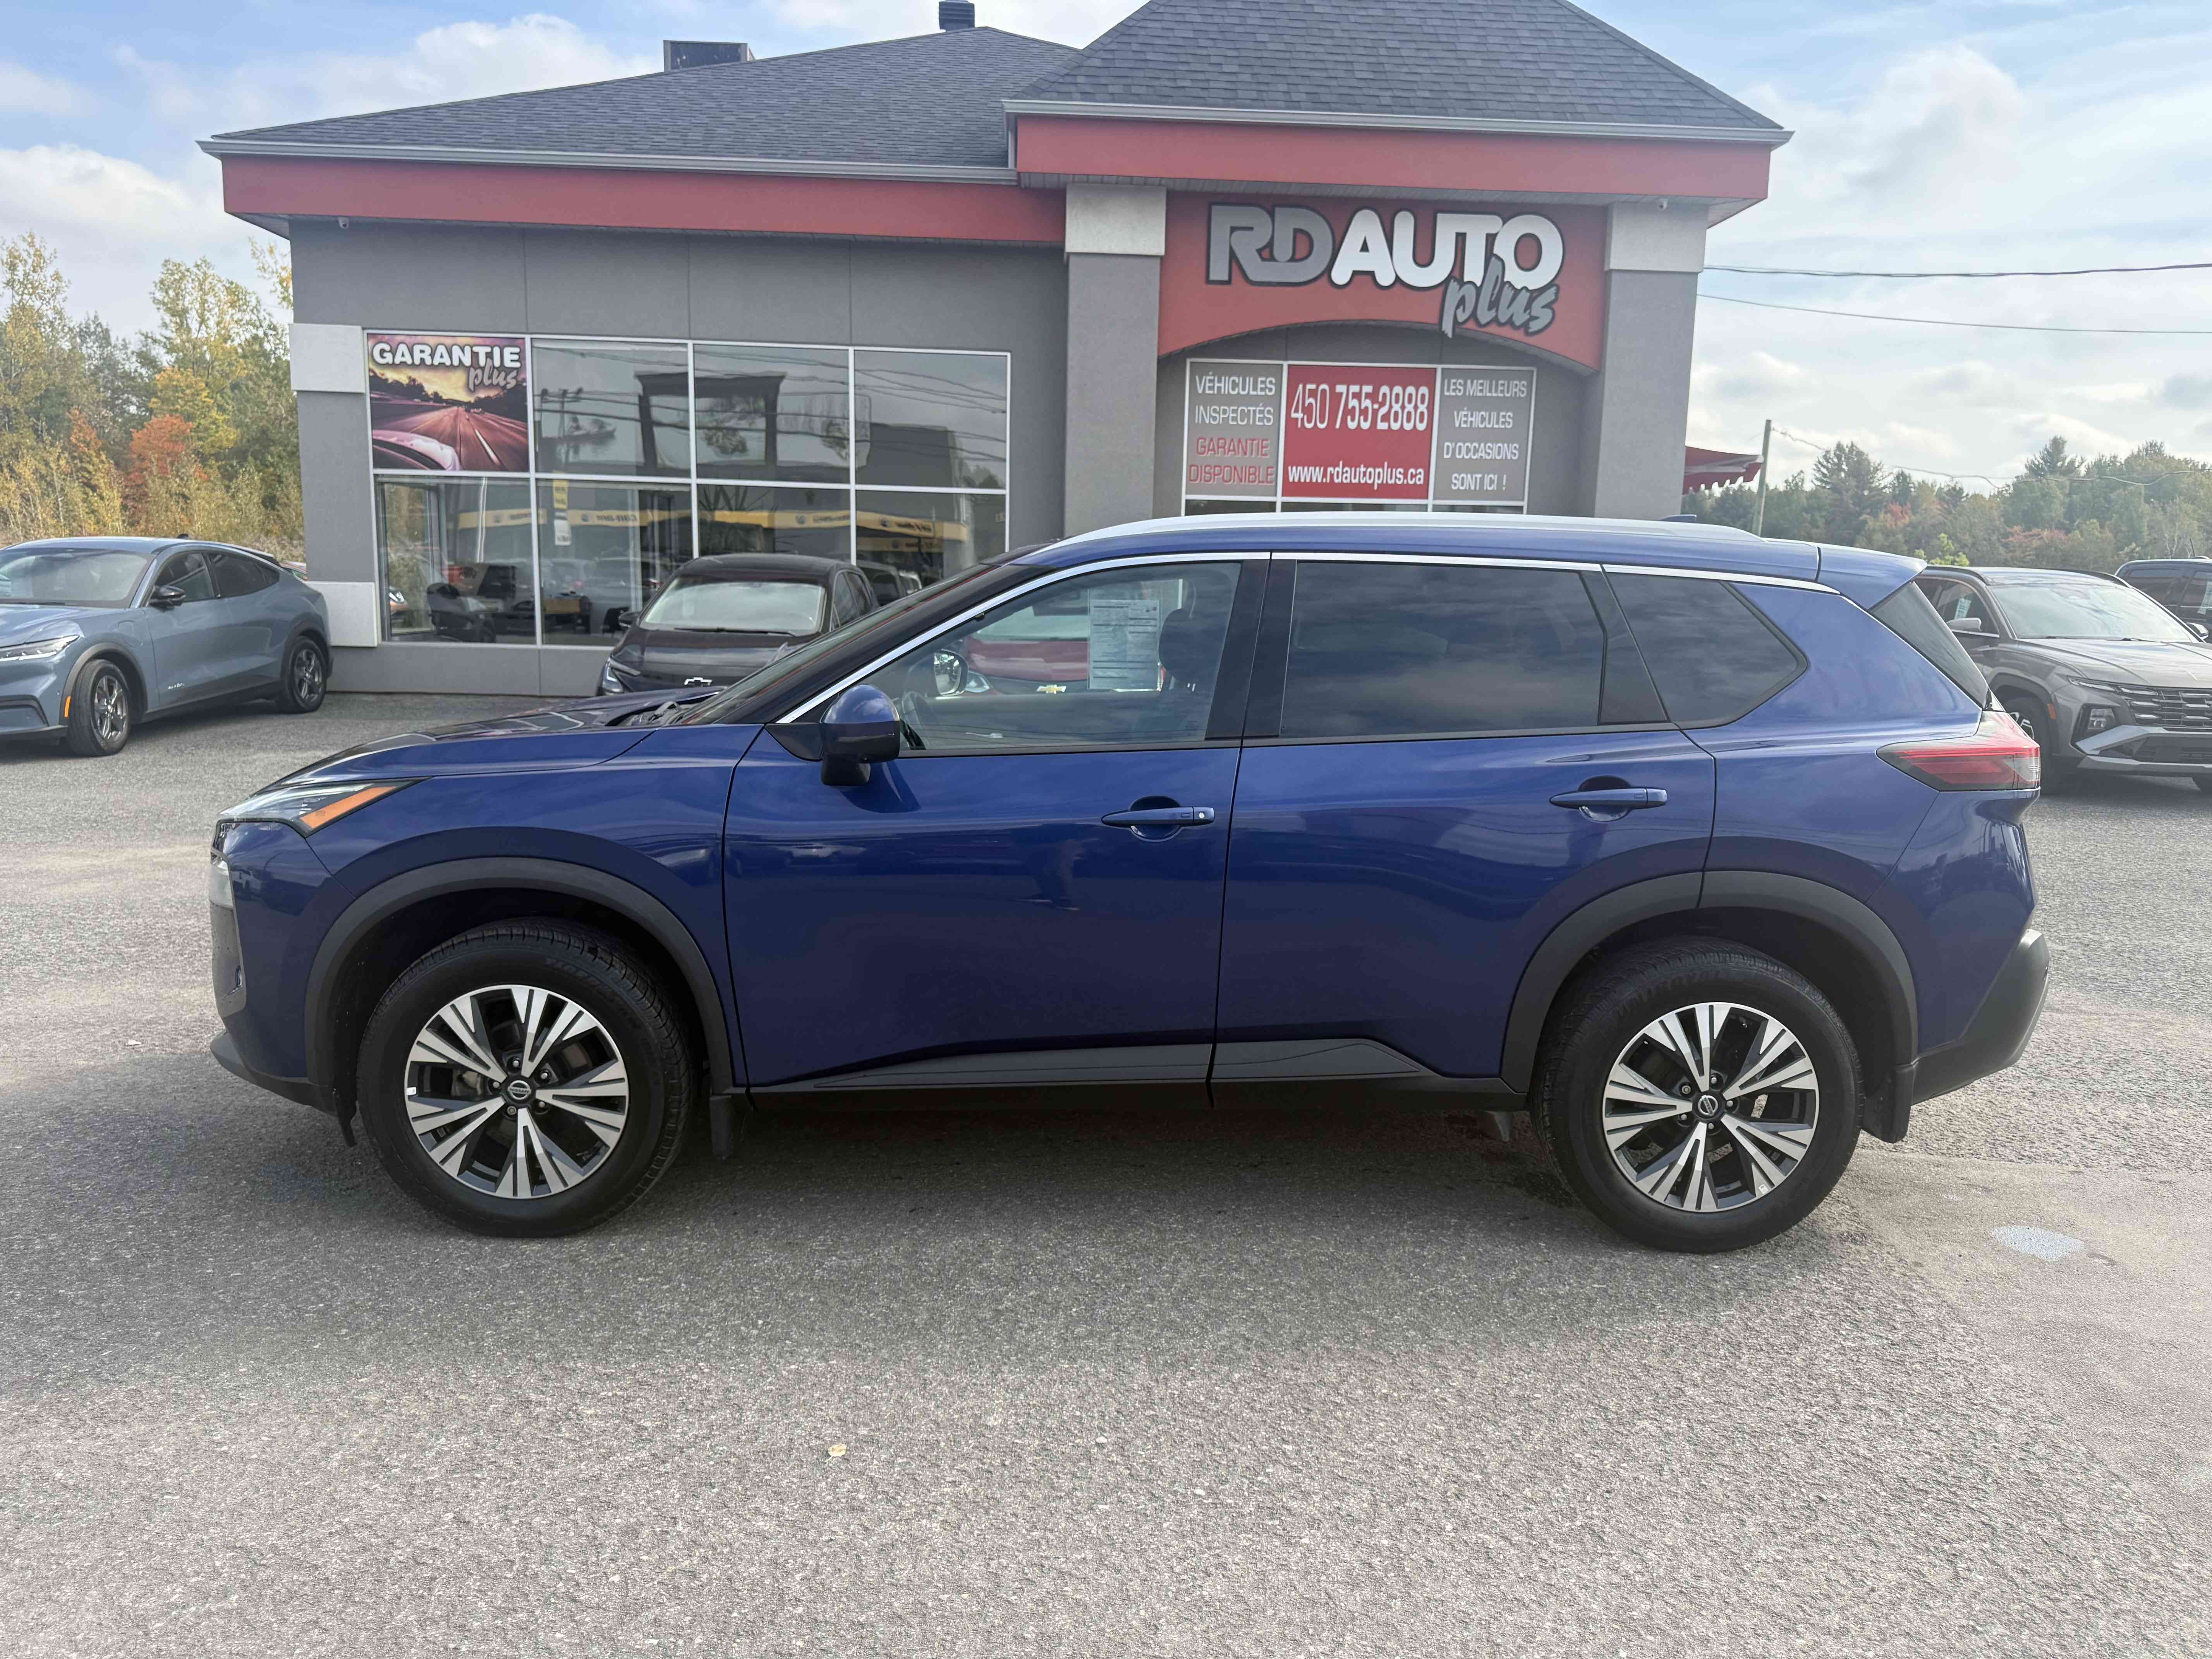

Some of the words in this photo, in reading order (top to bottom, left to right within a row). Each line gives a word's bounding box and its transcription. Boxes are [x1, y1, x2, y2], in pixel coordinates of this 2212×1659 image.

[1441, 253, 1560, 338] plus
[373, 342, 521, 368] GARANTIE
[469, 357, 517, 392] plus
[1195, 371, 1276, 396] VÉHICULES
[1443, 379, 1464, 396] LES
[1466, 380, 1528, 397] MEILLEURS
[1195, 403, 1274, 426] INSPECTÉS
[1290, 383, 1330, 429] 450
[1335, 384, 1429, 431] 755-2888
[1453, 407, 1513, 429] VÉHICULES
[1196, 437, 1271, 458] GARANTIE
[1189, 464, 1275, 486] DISPONIBLE
[1288, 460, 1425, 490] www.rdautoplus.ca
[1451, 473, 1482, 490] SONT
[1484, 474, 1498, 491] ICI
